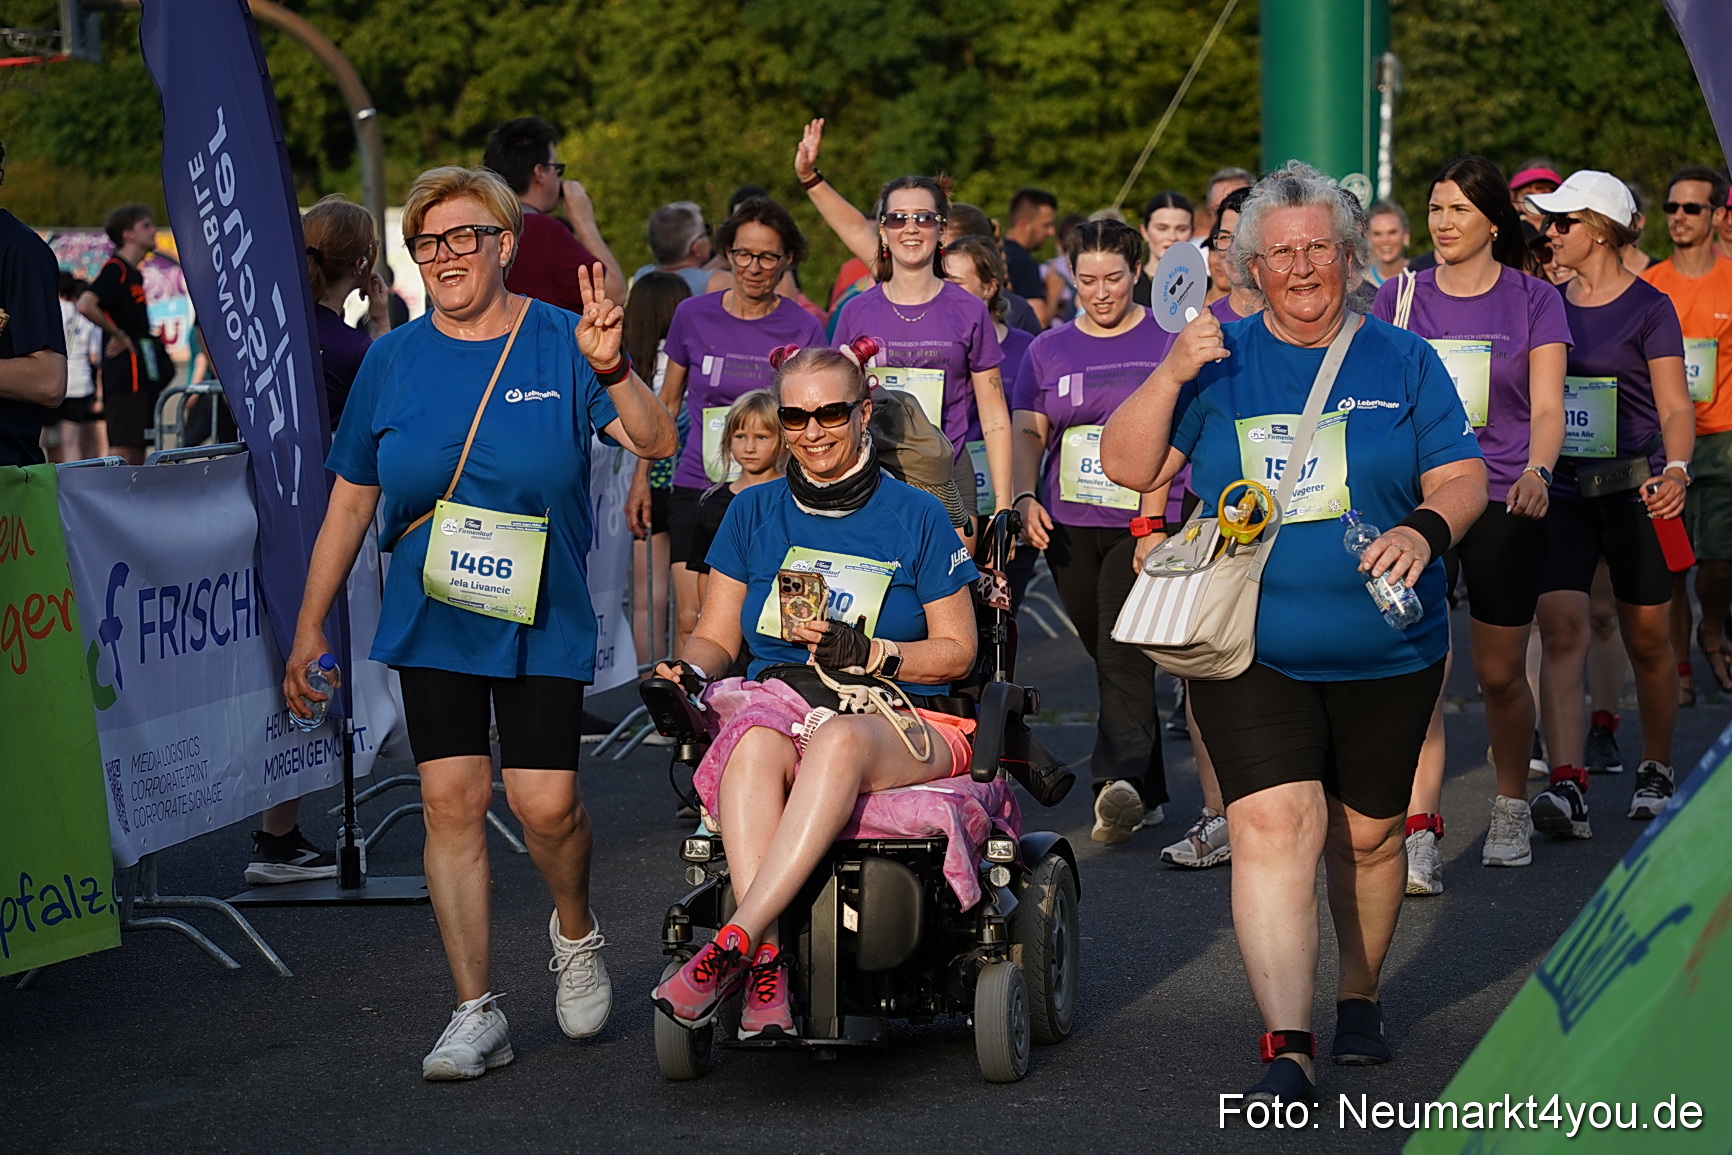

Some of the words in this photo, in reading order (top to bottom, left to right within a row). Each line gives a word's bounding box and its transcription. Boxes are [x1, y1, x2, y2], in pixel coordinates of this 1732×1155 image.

[524, 390, 561, 400] Lebenshilfe
[1357, 400, 1400, 409] Lebenshilfe
[1267, 433, 1296, 441] Firmenla
[1077, 476, 1104, 486] Jennifer
[458, 528, 493, 538] Firmenlauf
[450, 550, 514, 580] 1466
[449, 577, 469, 589] Jela
[470, 580, 512, 595] Livancic
[263, 744, 305, 785] MORGEN
[131, 768, 186, 802] CORPORATE
[186, 760, 209, 785] PRINT
[133, 793, 188, 829] CORPORATE
[188, 782, 223, 812] SIGNAGE
